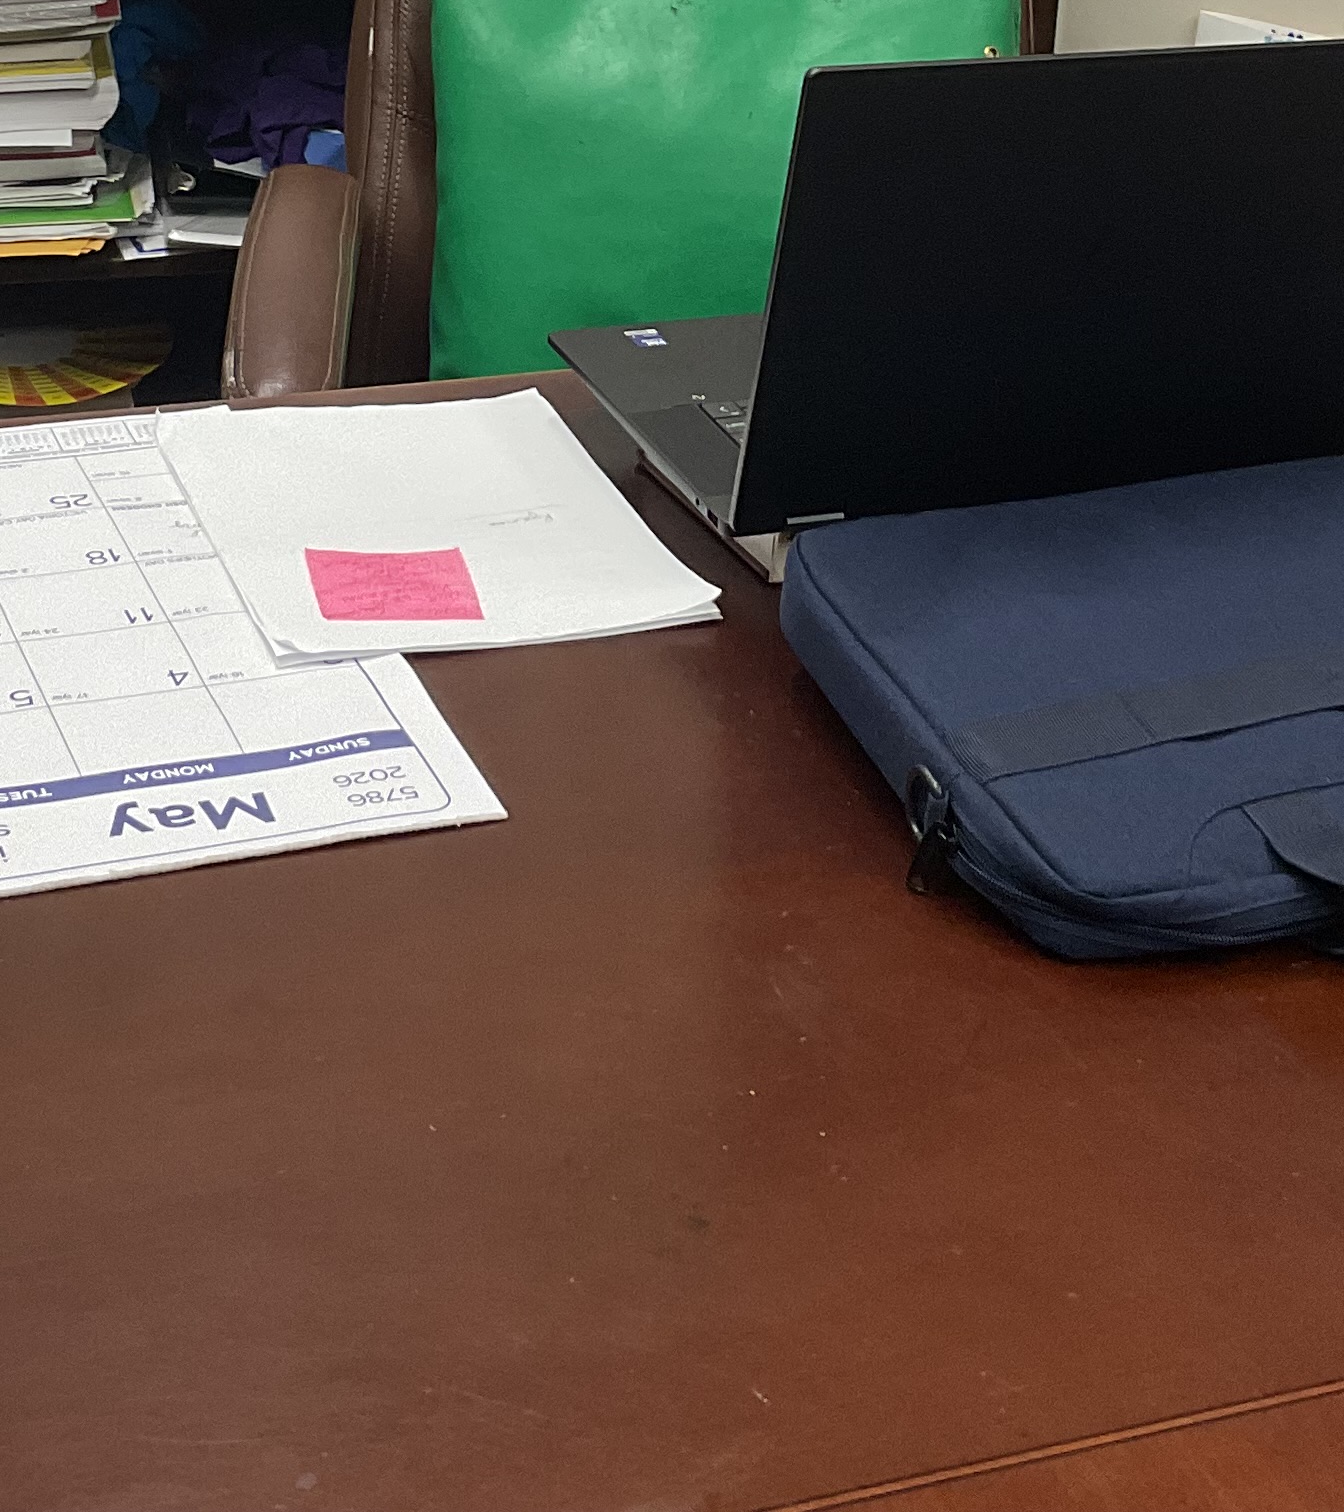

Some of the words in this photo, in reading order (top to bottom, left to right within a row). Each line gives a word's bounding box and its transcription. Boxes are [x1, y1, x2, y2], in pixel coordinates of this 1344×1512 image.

[49, 494, 93, 509] 25
[85, 548, 121, 565] 18
[123, 606, 154, 624] 11
[167, 669, 189, 686] 4
[9, 690, 34, 707] 5
[289, 738, 370, 761] SUNDAY
[123, 762, 214, 784] MONDAY
[333, 766, 406, 787] 2026
[347, 786, 419, 807] 5786
[110, 792, 276, 837] May
